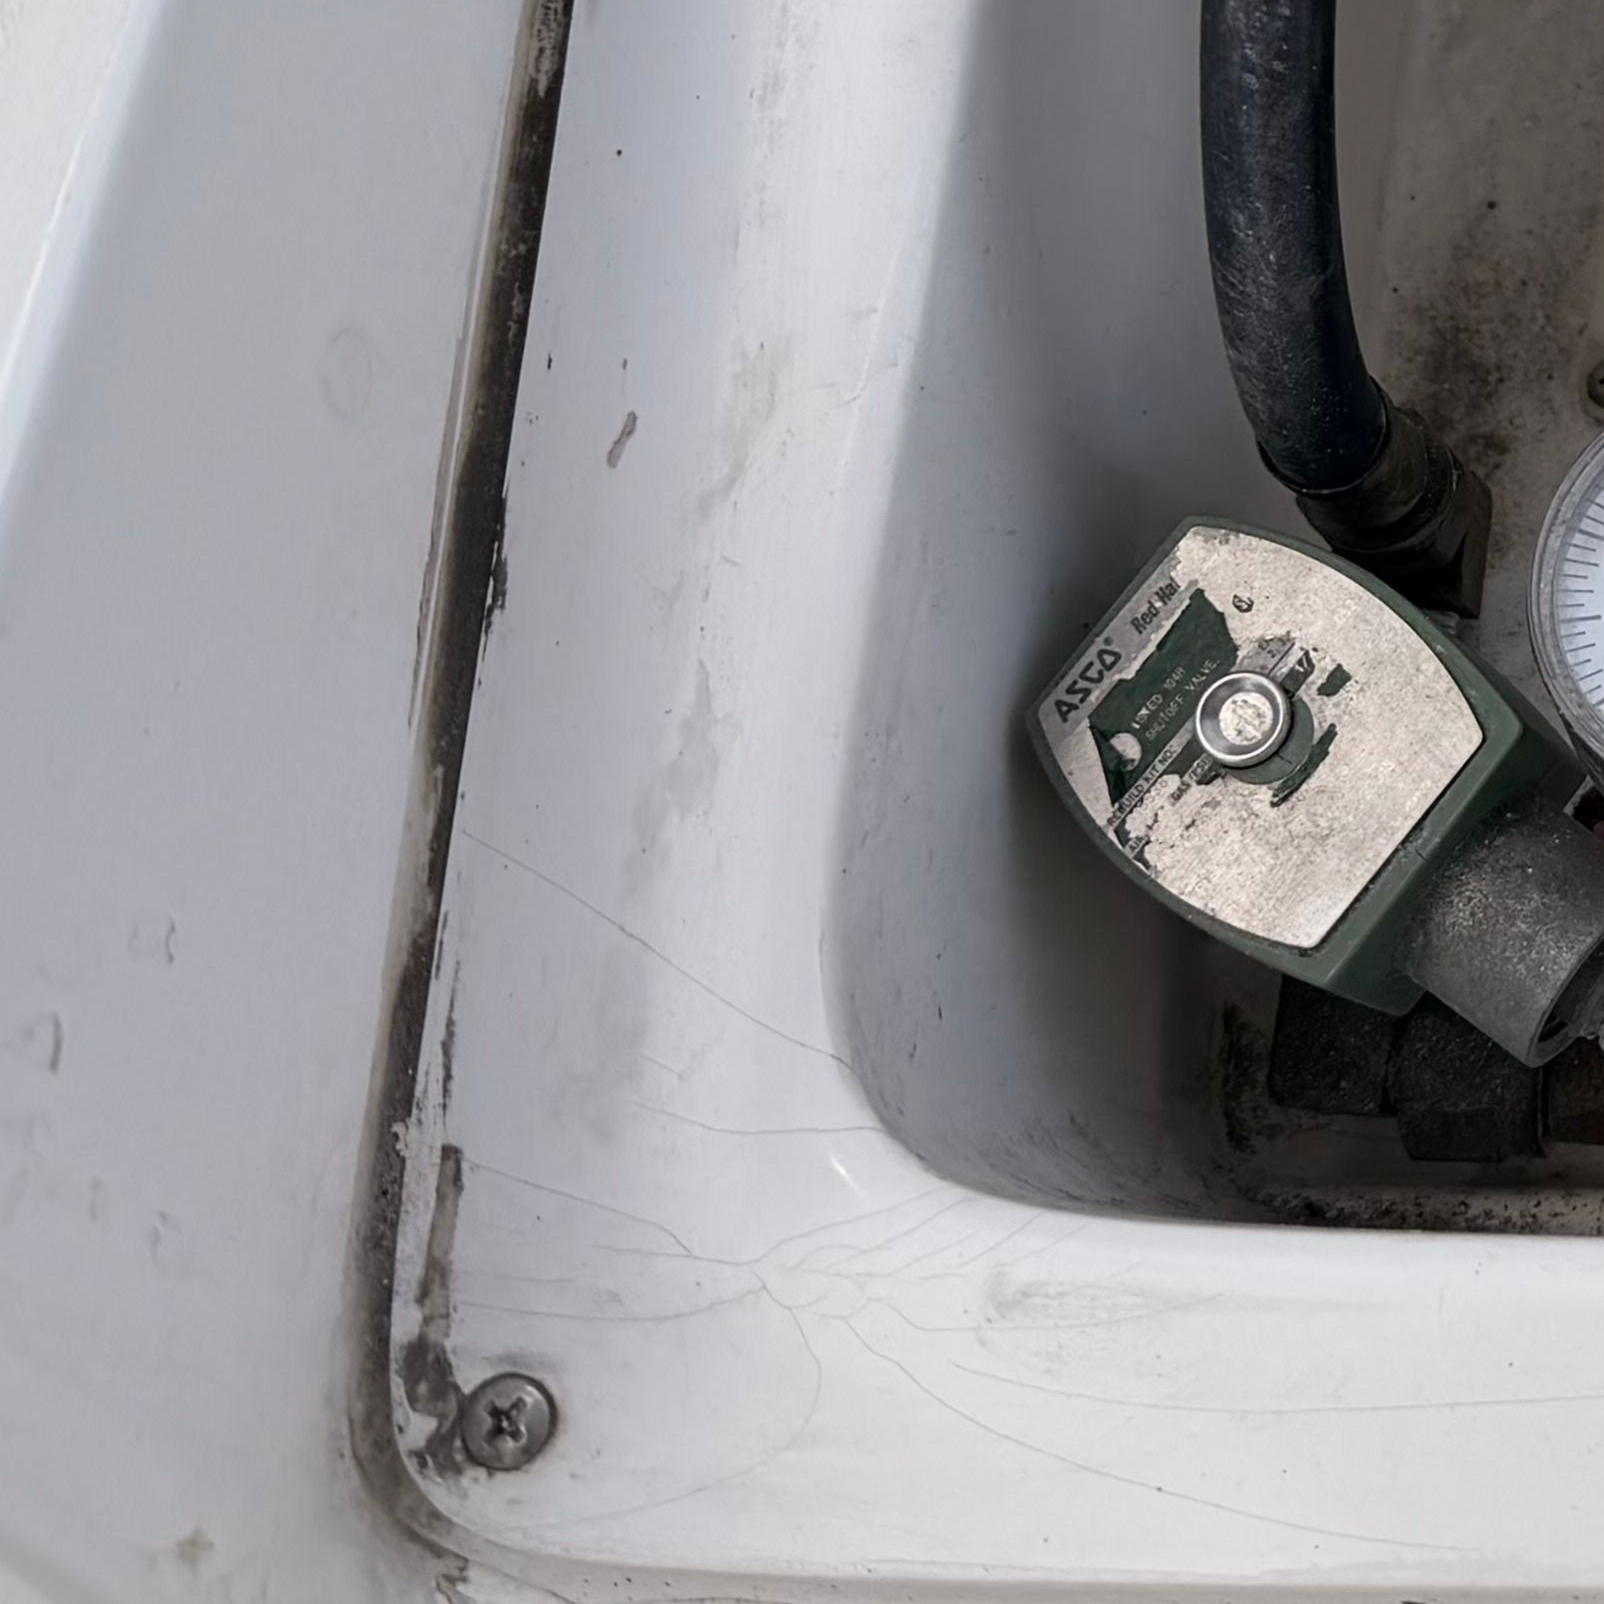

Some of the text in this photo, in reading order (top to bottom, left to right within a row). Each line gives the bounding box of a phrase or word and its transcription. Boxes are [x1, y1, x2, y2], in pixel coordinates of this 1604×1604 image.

[1129, 599, 1160, 635] Red
[1144, 695, 1186, 740] SHUTOFF
[1143, 764, 1160, 787] KIT
